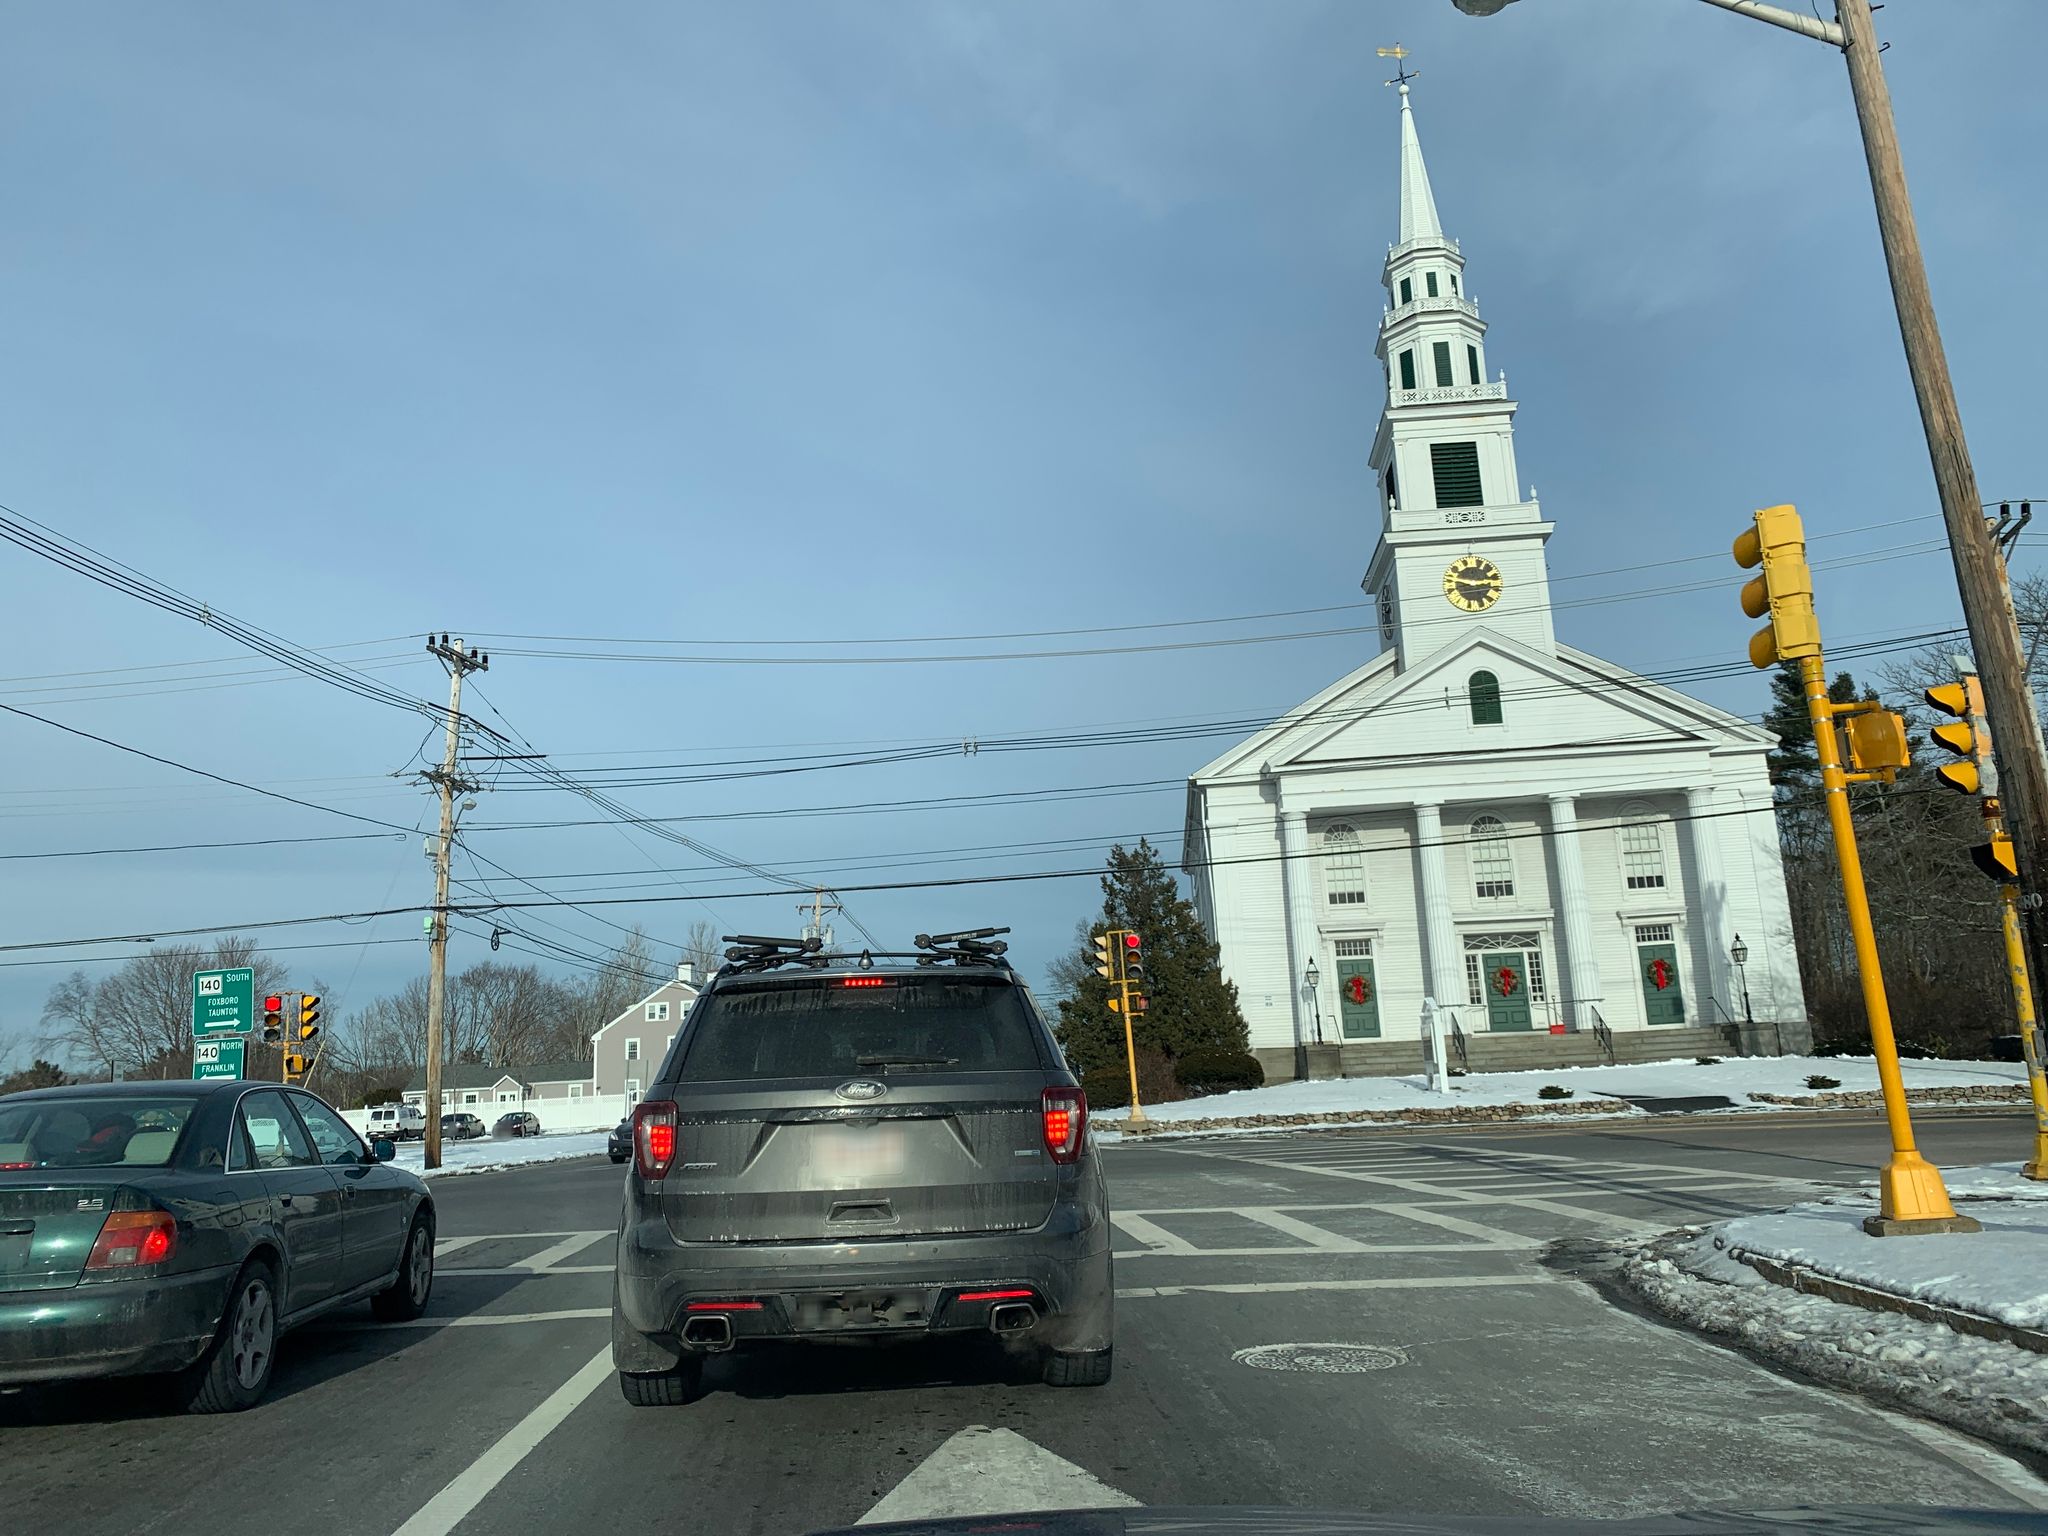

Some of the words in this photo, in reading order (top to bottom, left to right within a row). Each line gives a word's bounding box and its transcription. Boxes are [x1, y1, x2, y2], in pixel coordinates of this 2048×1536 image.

[200, 979, 220, 991] 140
[226, 973, 249, 982] SOUTH
[208, 996, 239, 1006] FOXBORO
[208, 1007, 238, 1016] TAUNTON
[198, 1047, 218, 1058] 140
[221, 1041, 243, 1050] NORTH
[201, 1063, 235, 1073] FRANKLIN
[847, 1082, 876, 1097] Ford
